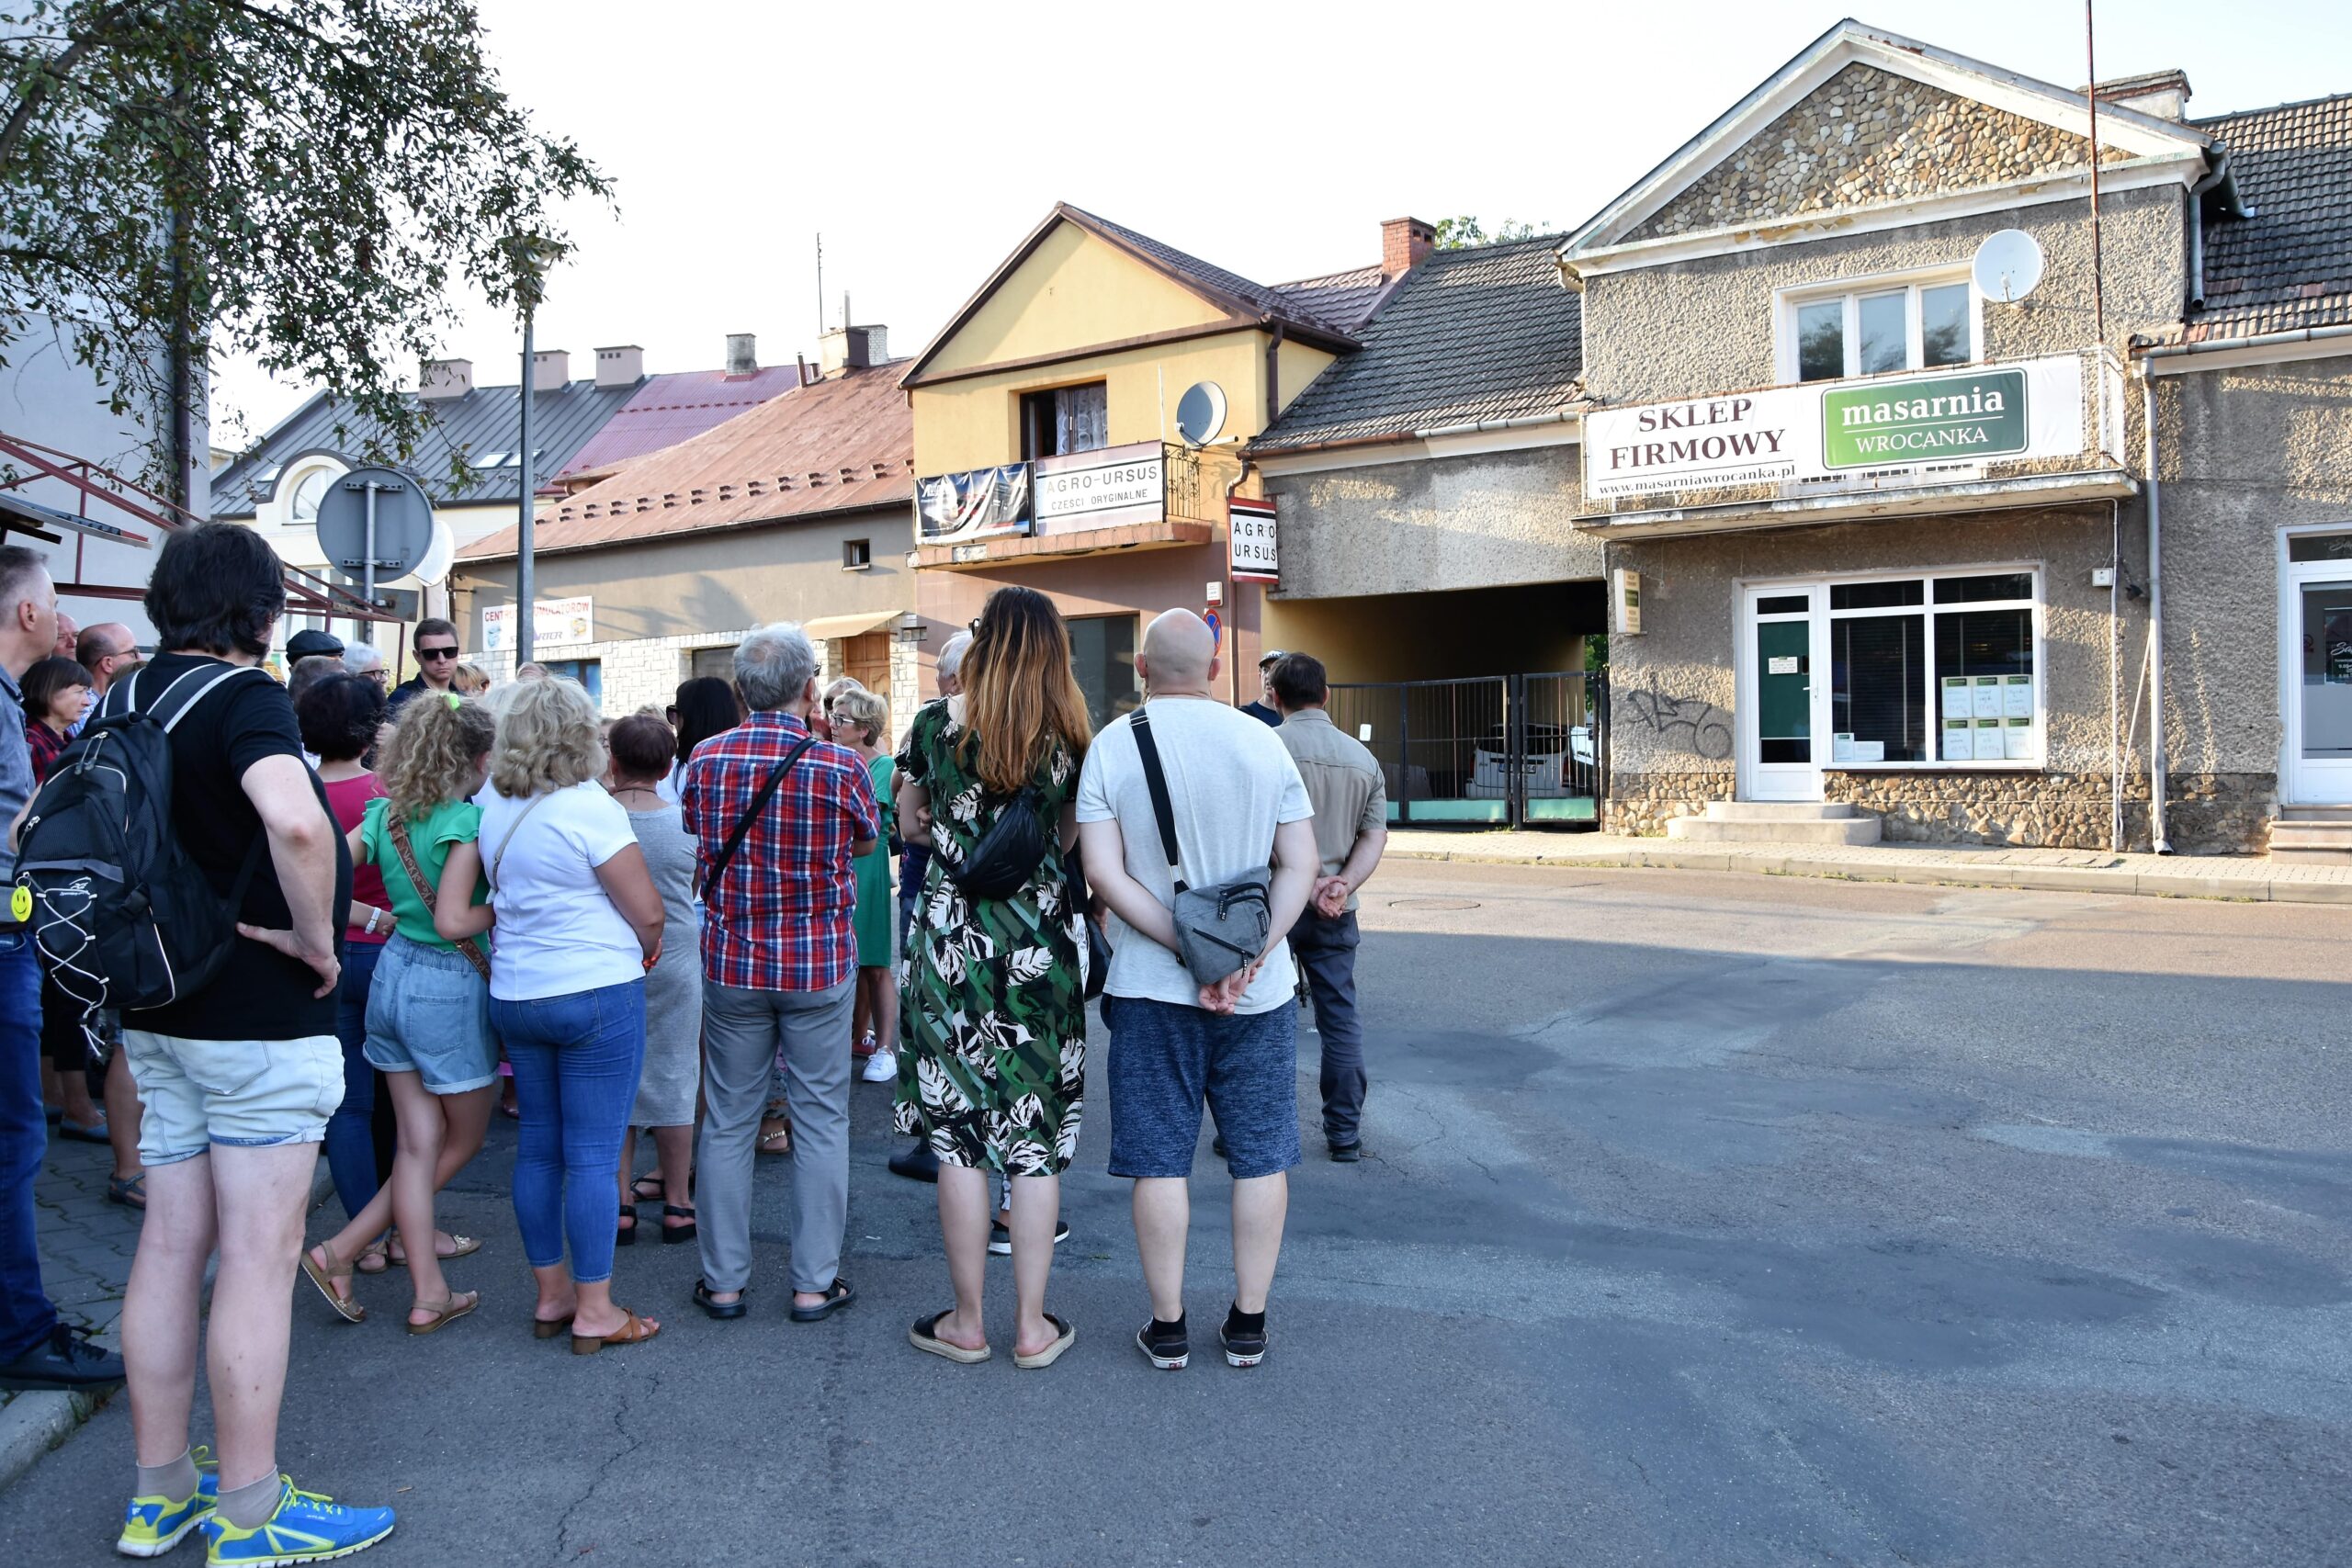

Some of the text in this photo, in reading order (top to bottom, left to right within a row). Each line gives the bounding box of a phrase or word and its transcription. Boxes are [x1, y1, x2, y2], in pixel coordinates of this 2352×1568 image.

[1638, 398, 1752, 433] SKLEP
[1842, 386, 2005, 426] masarnia
[1610, 428, 1786, 470] FIRMOWY
[1855, 426, 1989, 454] WROCANKA
[1046, 466, 1158, 494] AGRO-URSUS
[1599, 465, 1796, 495] www.masarniawrocanka.pl
[1091, 488, 1148, 505] ORYGINALNE
[1233, 521, 1275, 538] AGRO
[1234, 543, 1276, 562] URSUS
[484, 602, 590, 623] CENTRU UMULATOROW
